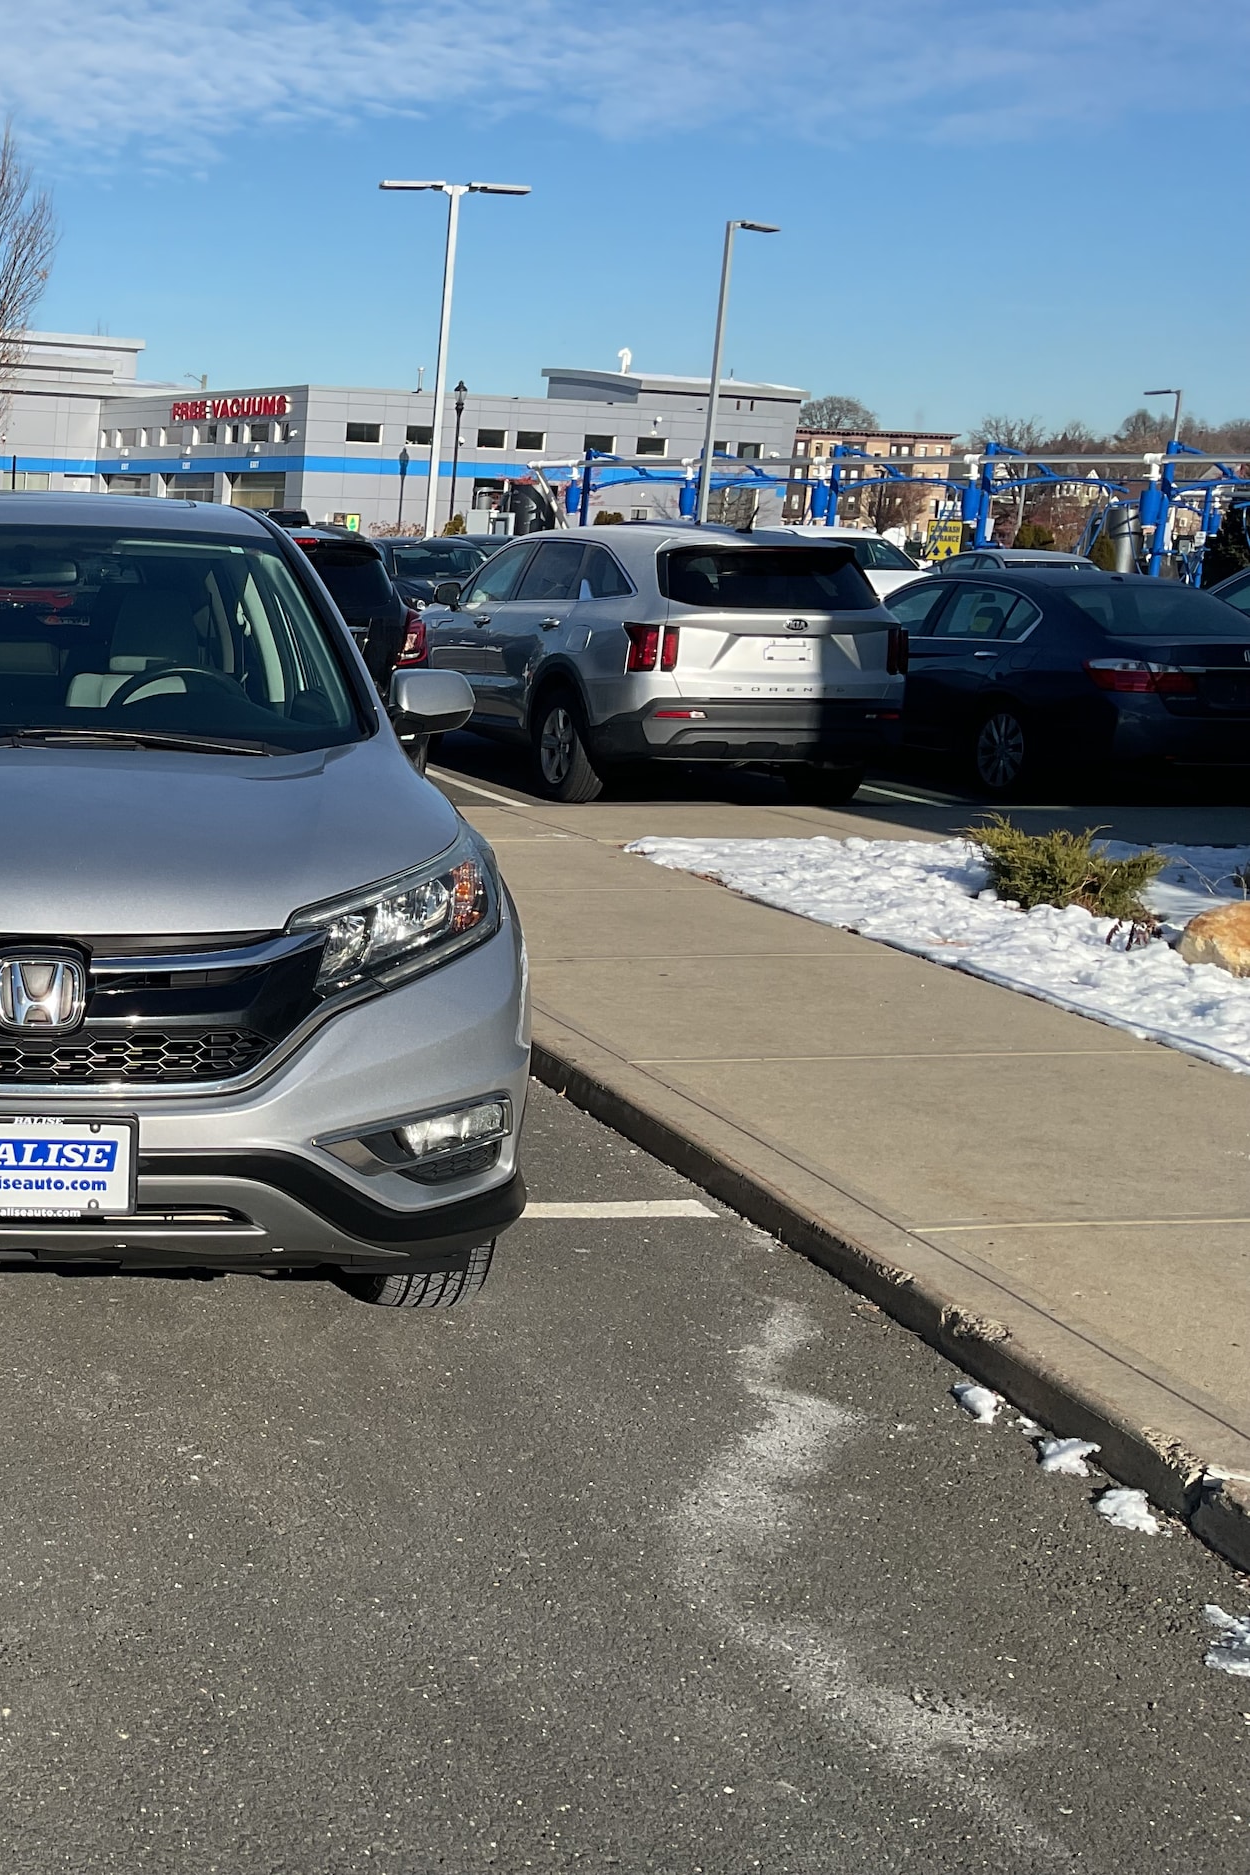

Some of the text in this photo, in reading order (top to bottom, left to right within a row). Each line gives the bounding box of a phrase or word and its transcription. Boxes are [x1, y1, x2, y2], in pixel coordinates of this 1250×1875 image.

[172, 395, 287, 420] FREE VACUUMS
[789, 620, 806, 630] KIA
[13, 1116, 65, 1125] BALISE
